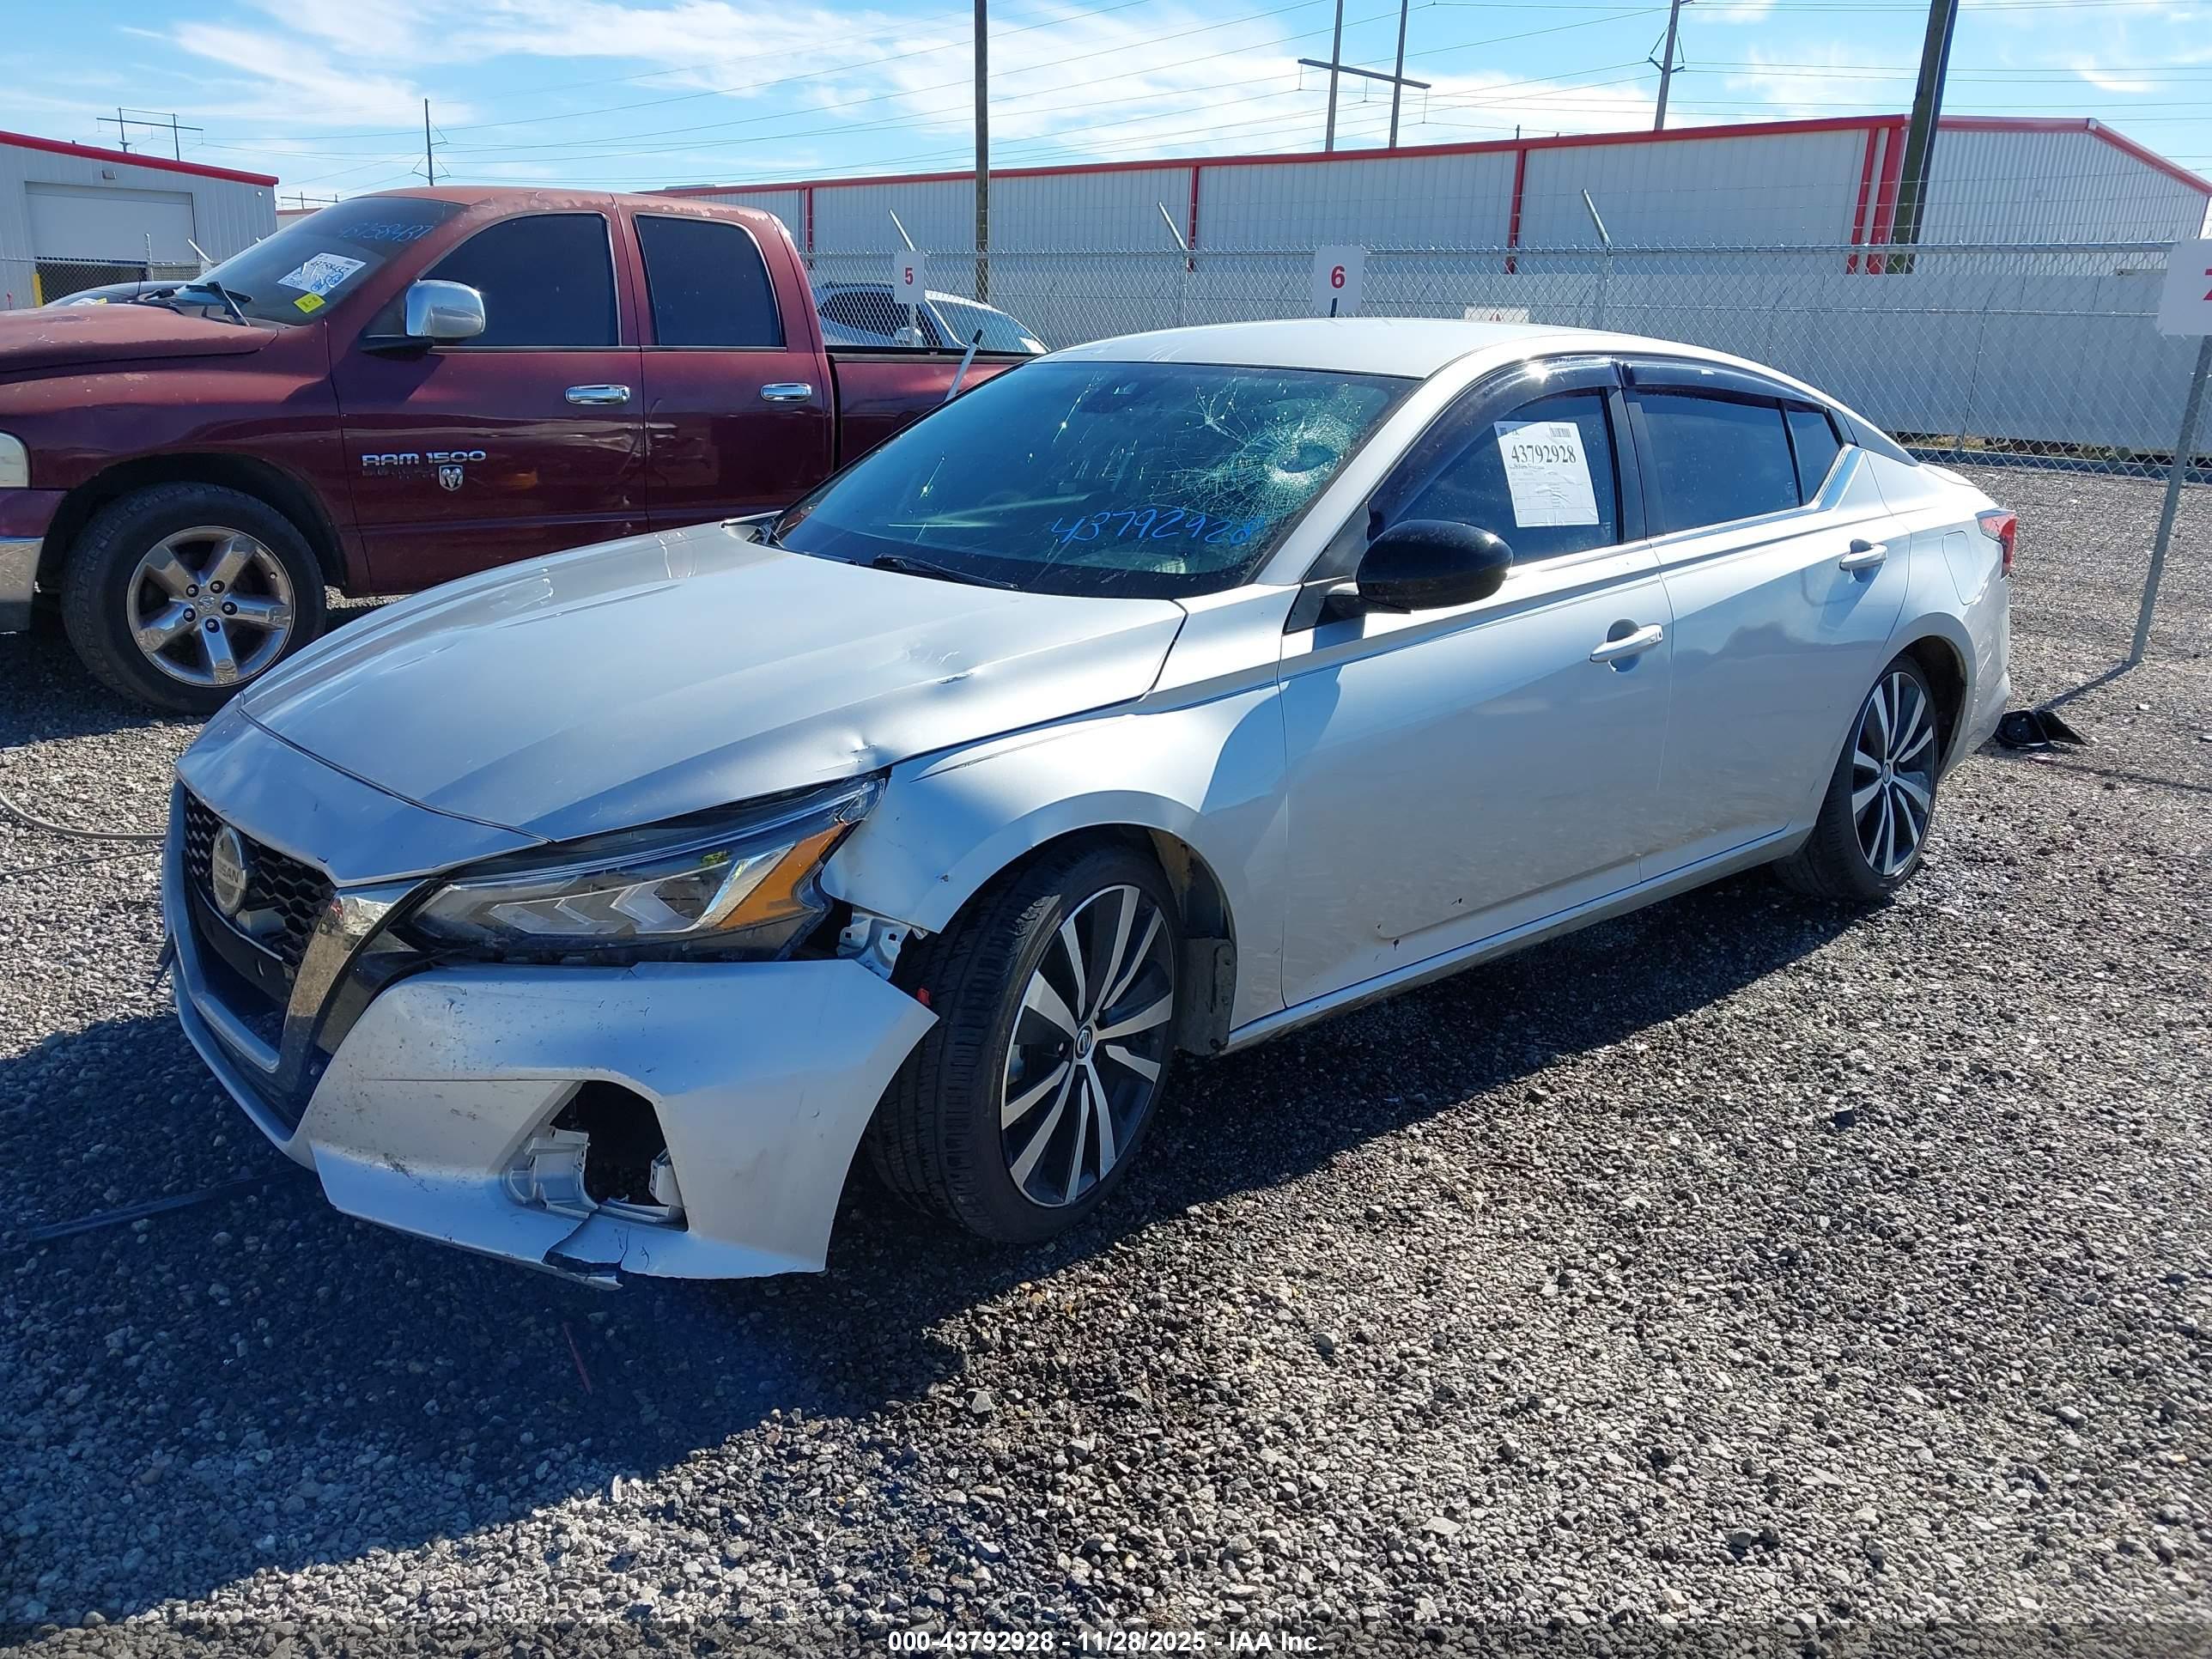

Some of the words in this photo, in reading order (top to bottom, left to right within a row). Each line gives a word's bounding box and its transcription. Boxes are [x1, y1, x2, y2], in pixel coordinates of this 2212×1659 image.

[904, 267, 914, 286] 5
[1331, 265, 1346, 289] 6
[362, 453, 420, 466] RAM
[425, 450, 487, 464] 1500
[1511, 444, 1577, 465] 43792928
[1050, 508, 1265, 547] 43792928
